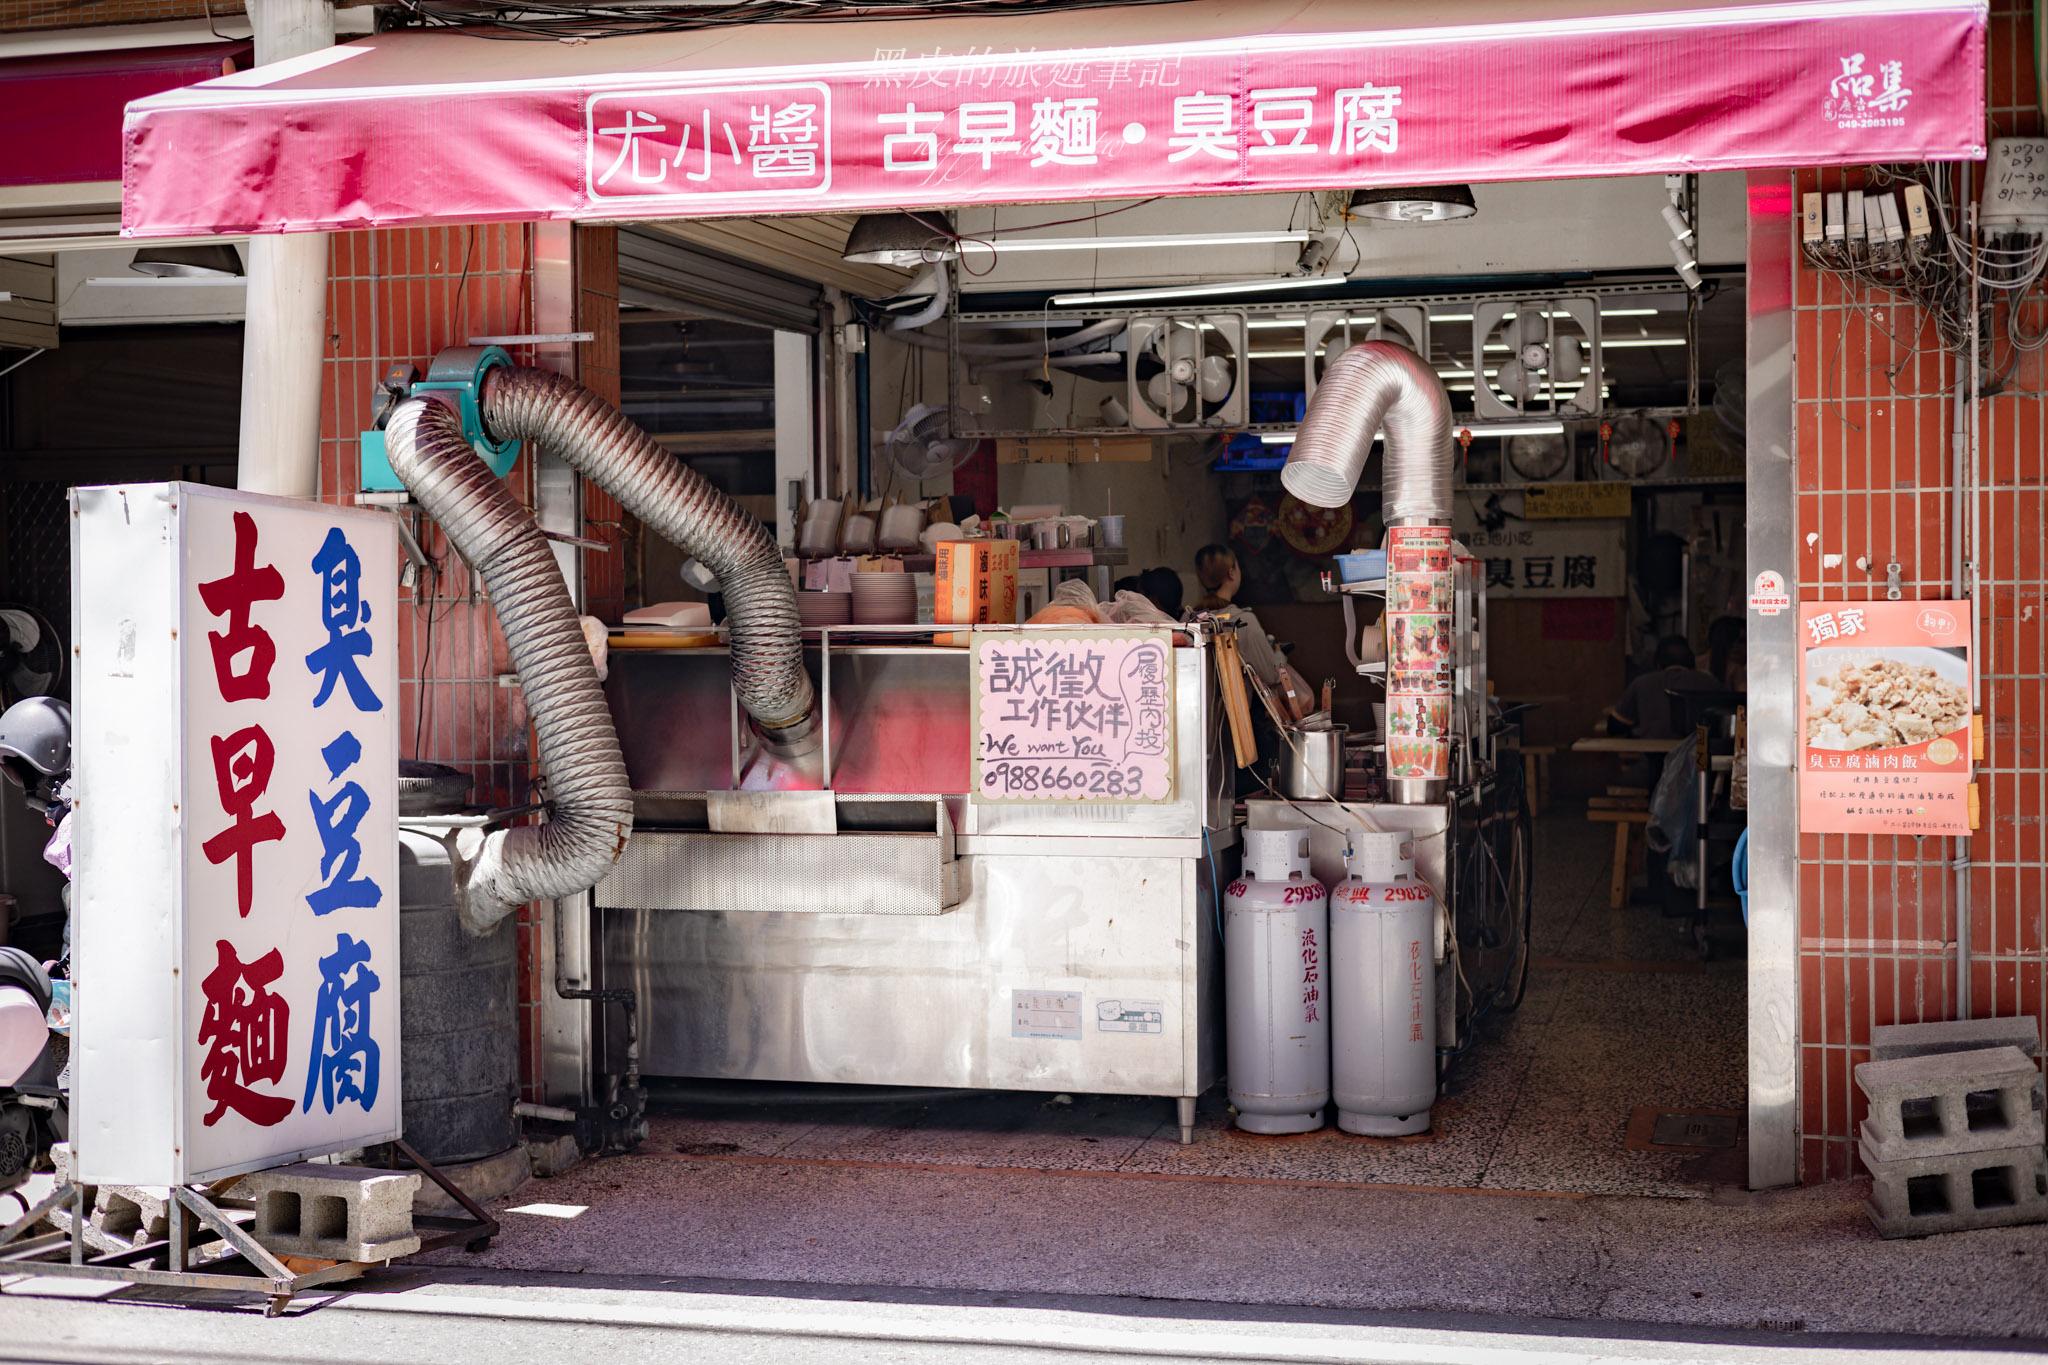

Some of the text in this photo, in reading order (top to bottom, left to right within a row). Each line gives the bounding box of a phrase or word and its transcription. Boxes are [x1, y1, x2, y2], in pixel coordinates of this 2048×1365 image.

[1829, 53, 1913, 113] 品集
[598, 102, 819, 186] 尤小醬
[1486, 555, 1598, 590] 臭豆腐
[1806, 608, 1867, 645] 獨家
[989, 647, 1122, 702] 誠徵
[1000, 696, 1130, 739] 工作伙伴
[986, 733, 1107, 758] We want You
[1810, 754, 1918, 769] 臭豆腐滷肉飯
[984, 762, 1144, 796] 0988660283
[197, 511, 296, 1128] 古早麵
[303, 526, 383, 1115] 臭豆腐
[1301, 928, 1320, 1024] 液化石油氣
